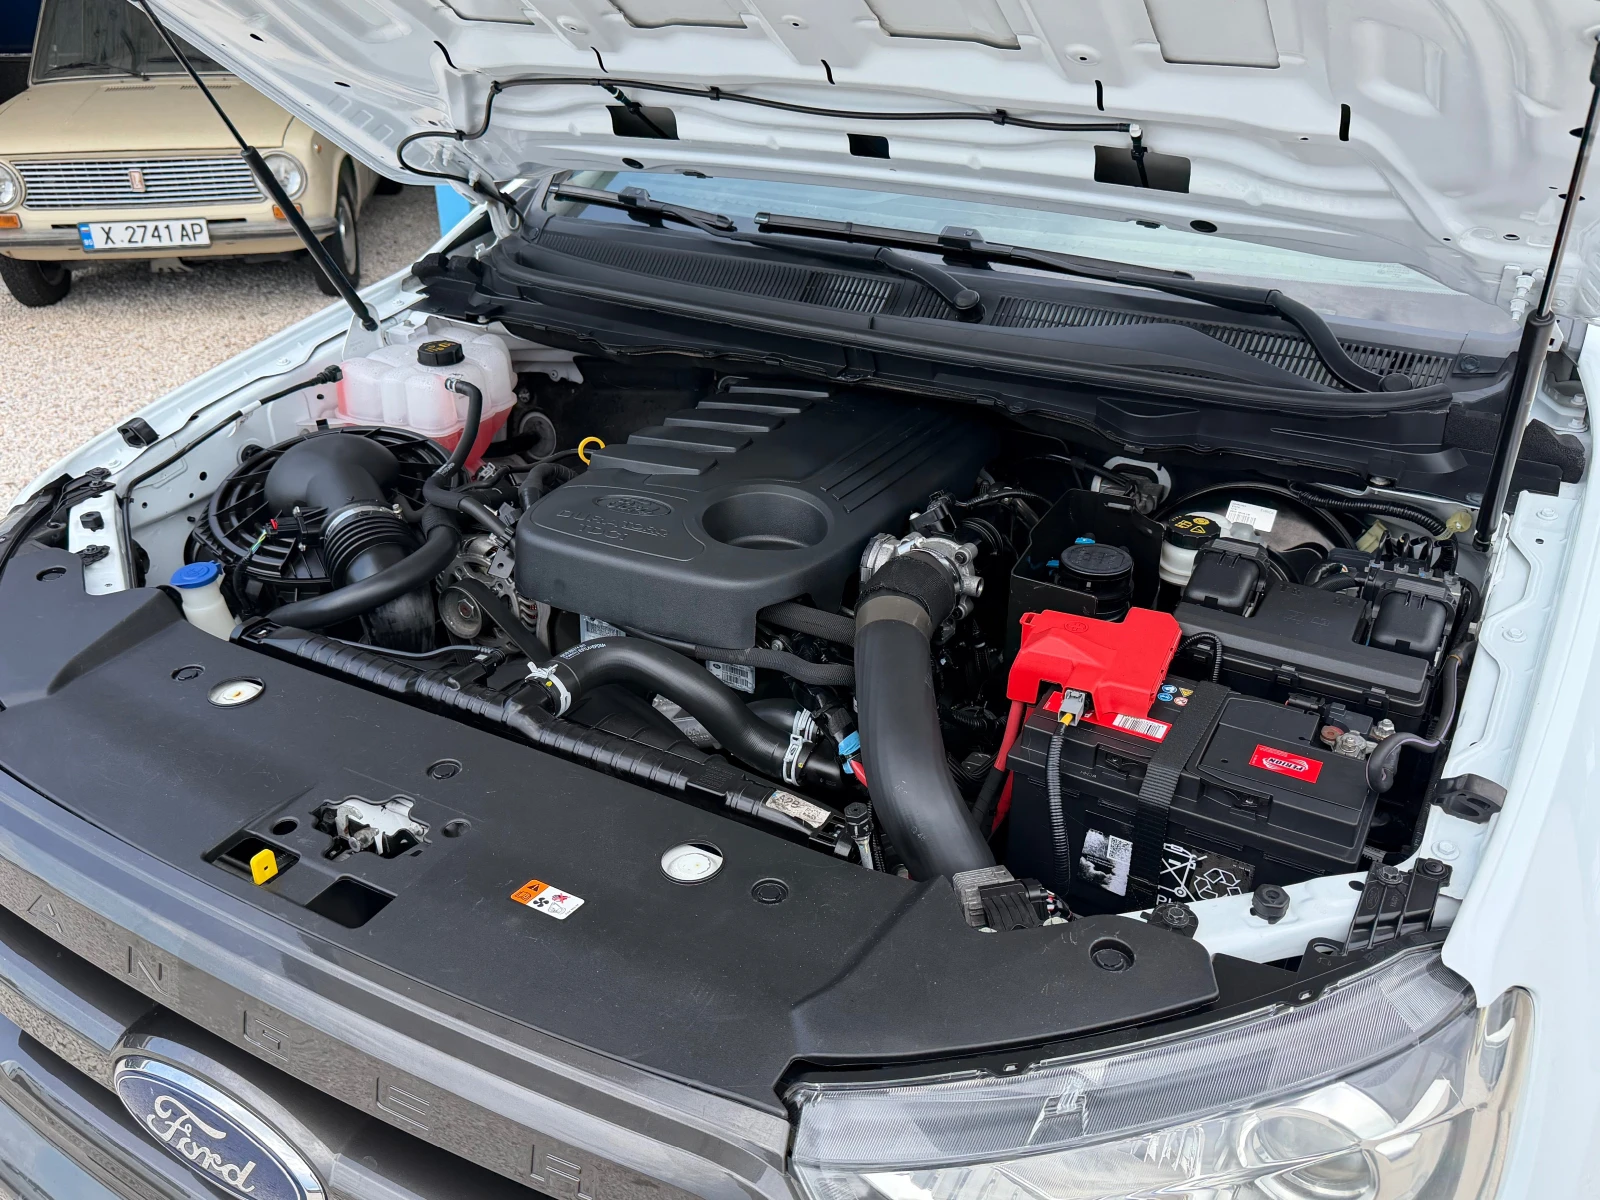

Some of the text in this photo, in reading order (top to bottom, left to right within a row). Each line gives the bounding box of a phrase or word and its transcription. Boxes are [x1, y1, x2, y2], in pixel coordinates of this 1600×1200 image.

[124, 224, 174, 244] 2741
[180, 223, 203, 242] AP
[1269, 757, 1303, 771] PERION
[146, 1095, 257, 1193] Ford
